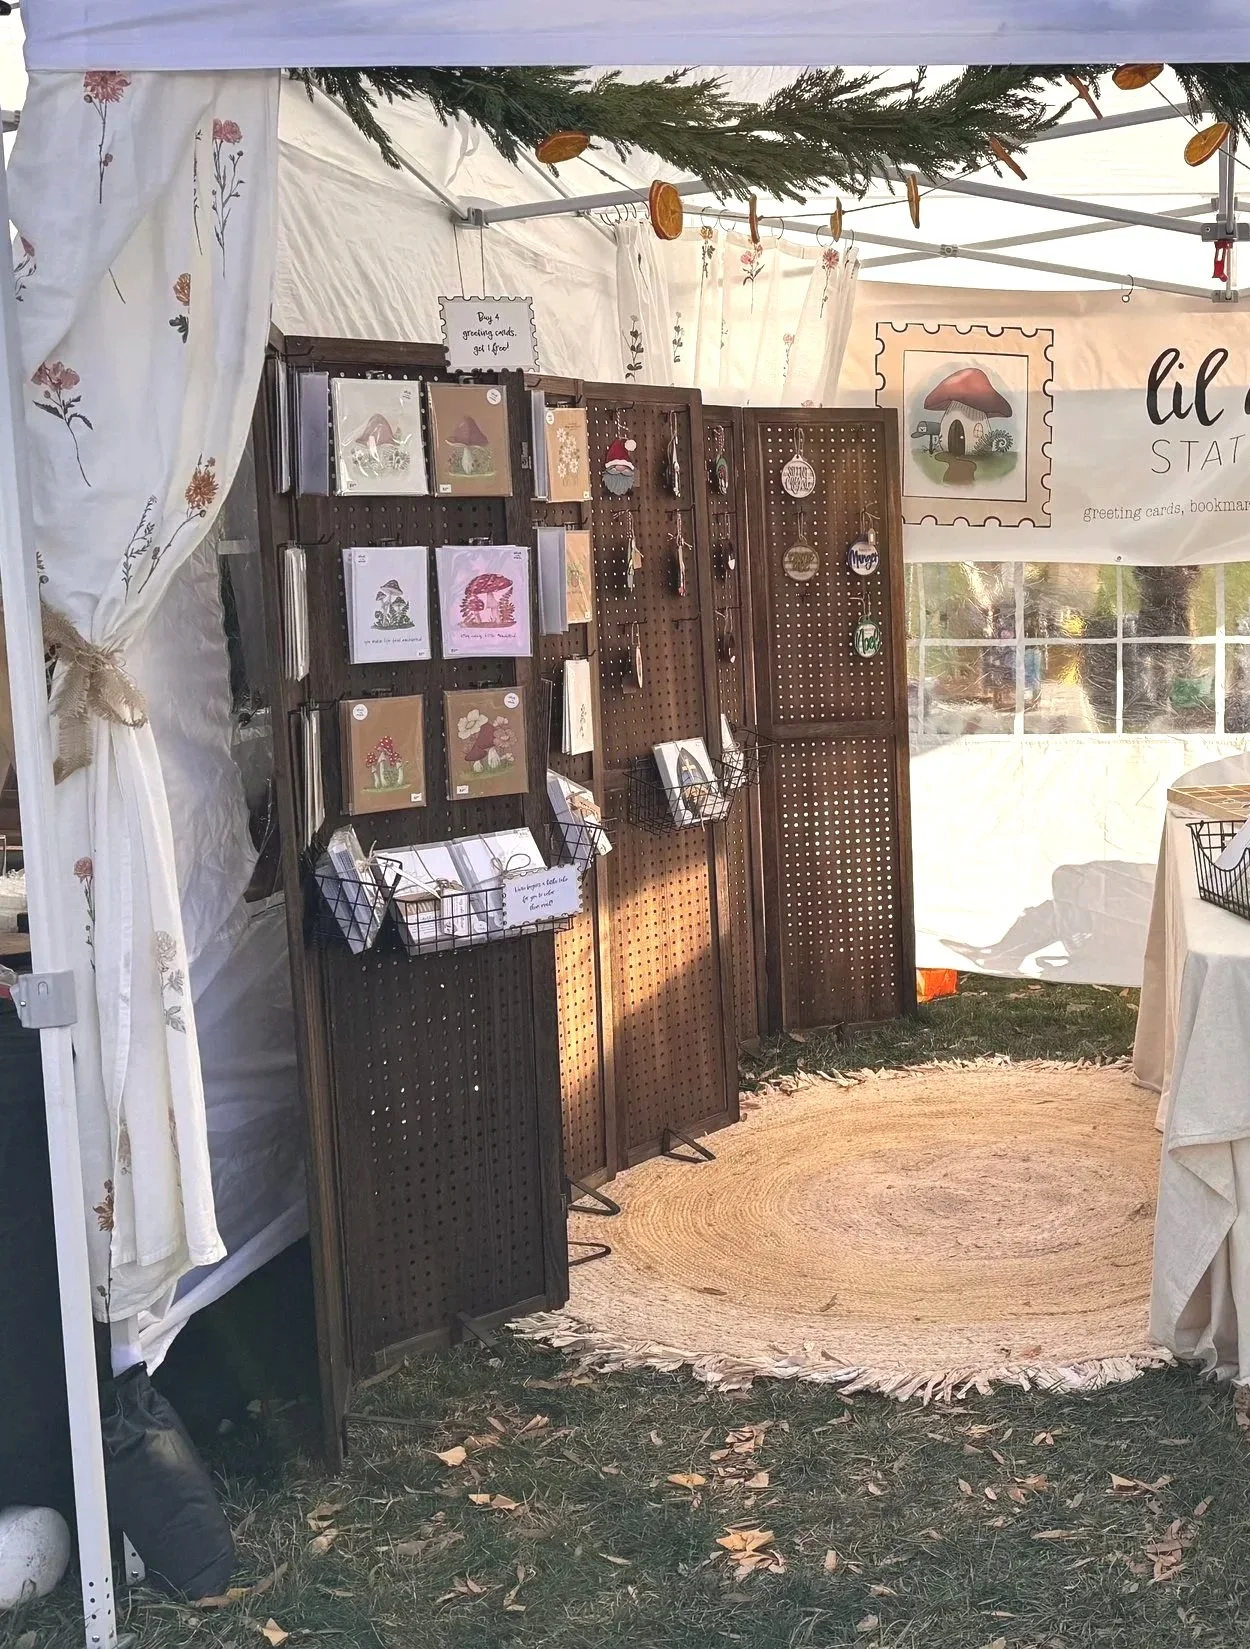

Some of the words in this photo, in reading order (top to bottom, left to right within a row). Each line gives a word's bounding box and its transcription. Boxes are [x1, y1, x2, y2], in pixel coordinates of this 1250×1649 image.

[477, 311, 492, 325] Buy
[462, 328, 493, 340] greeting
[473, 344, 485, 356] get
[1147, 347, 1228, 427] lil
[1083, 506, 1141, 522] greeting
[1145, 502, 1184, 518] cards,
